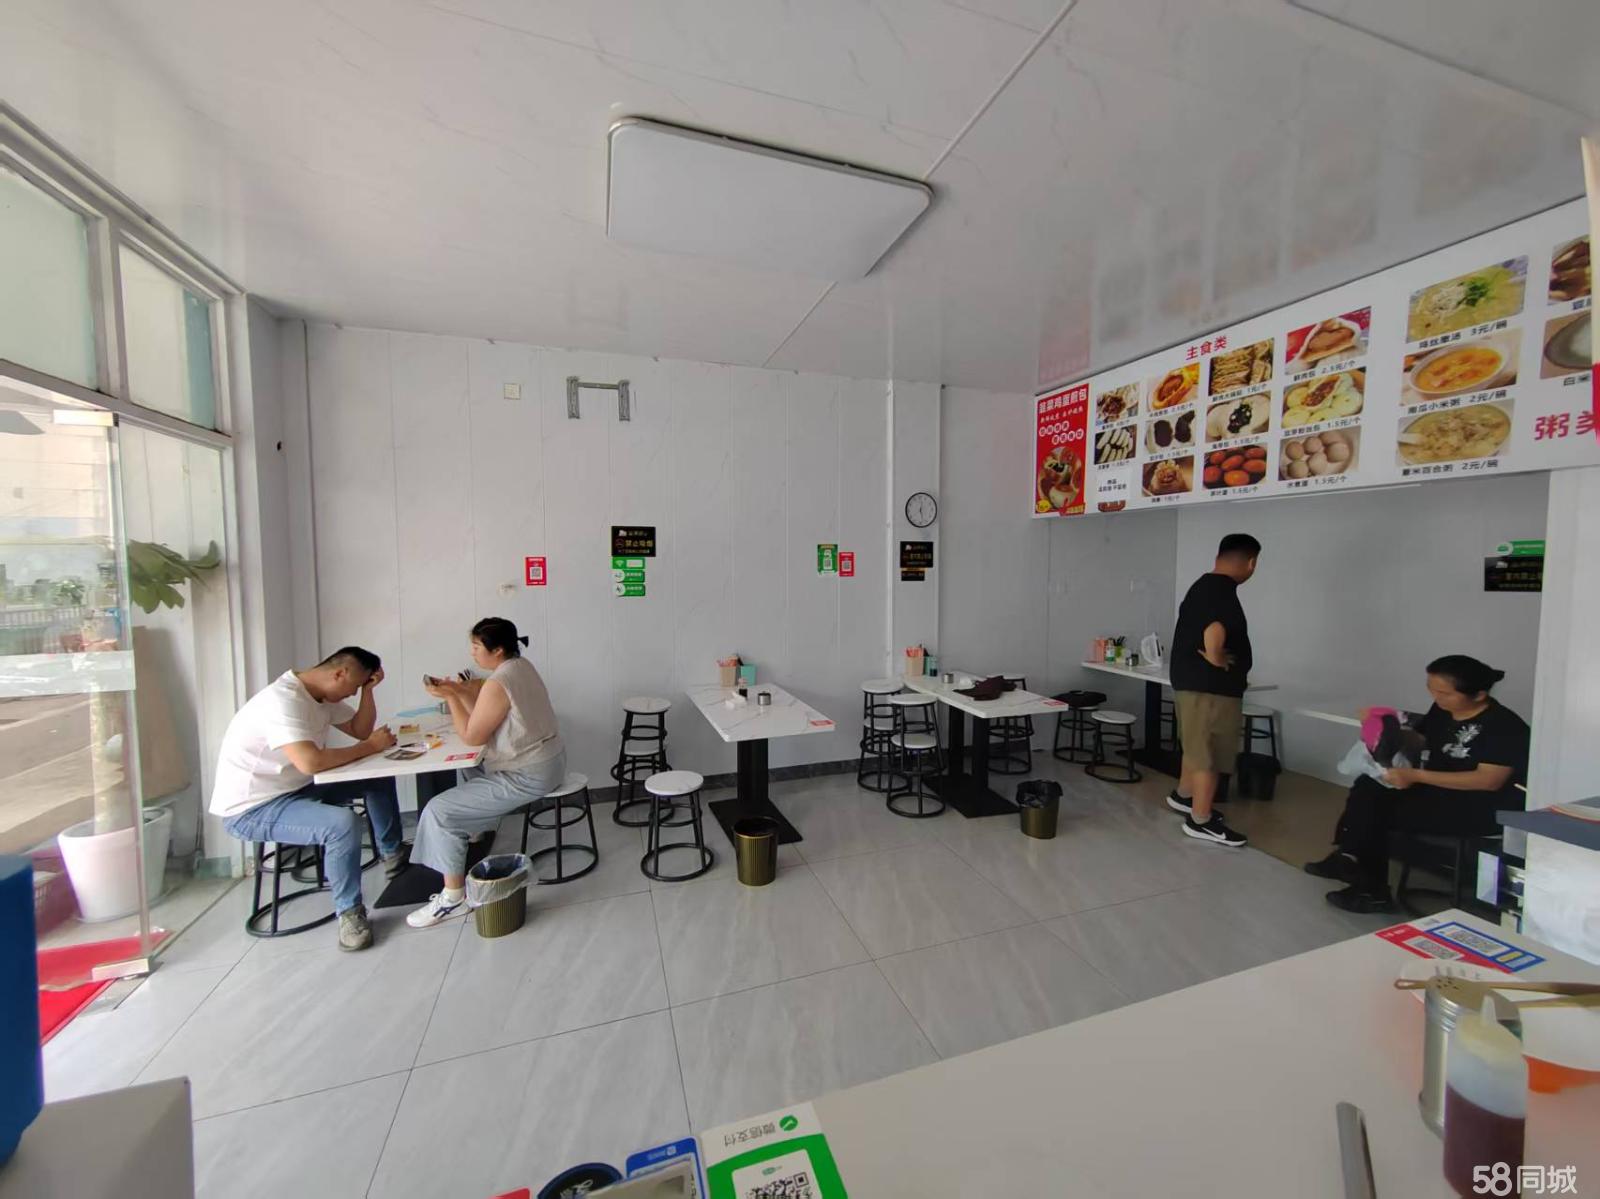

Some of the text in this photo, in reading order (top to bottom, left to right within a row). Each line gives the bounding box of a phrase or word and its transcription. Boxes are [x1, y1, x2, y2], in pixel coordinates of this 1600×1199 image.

[1186, 336, 1227, 360] 主食类
[1408, 390, 1507, 414] 南瓜小米粥 2元/碗
[1327, 417, 1361, 429] 1.5元/个
[1462, 458, 1499, 471] 2元/碗
[1314, 475, 1347, 486] 1.5元/个
[724, 1122, 776, 1147] 微信支付
